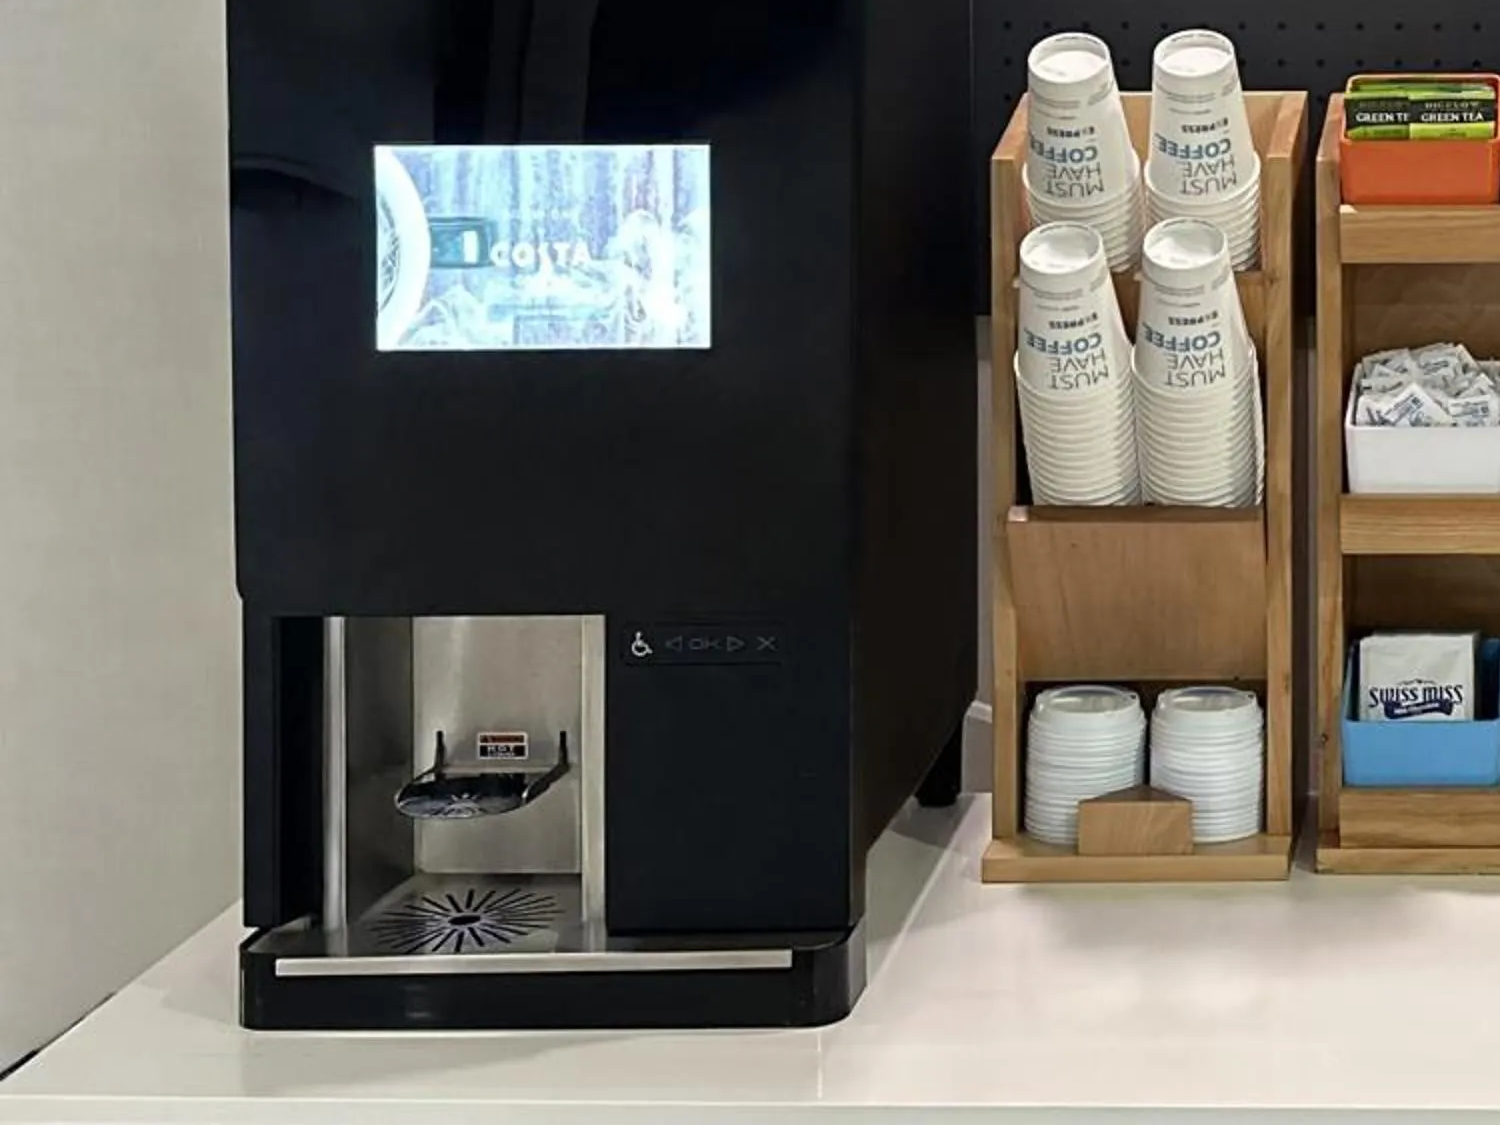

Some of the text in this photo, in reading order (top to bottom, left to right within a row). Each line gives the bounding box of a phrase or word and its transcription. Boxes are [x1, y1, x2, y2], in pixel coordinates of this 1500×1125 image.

[1355, 112, 1394, 122] GREEN
[1421, 112, 1485, 122] GREEN TEA
[1043, 162, 1102, 181] HAVE
[1178, 155, 1235, 178] HAVE
[1045, 178, 1104, 198] MUST
[1180, 171, 1237, 195] MUST
[1047, 348, 1106, 373] HAVE
[1163, 347, 1224, 370] HAVE
[1048, 365, 1109, 391] MUST
[1165, 364, 1226, 388] MUST
[1368, 686, 1418, 708] SWISS
[1422, 684, 1463, 704] MISS
